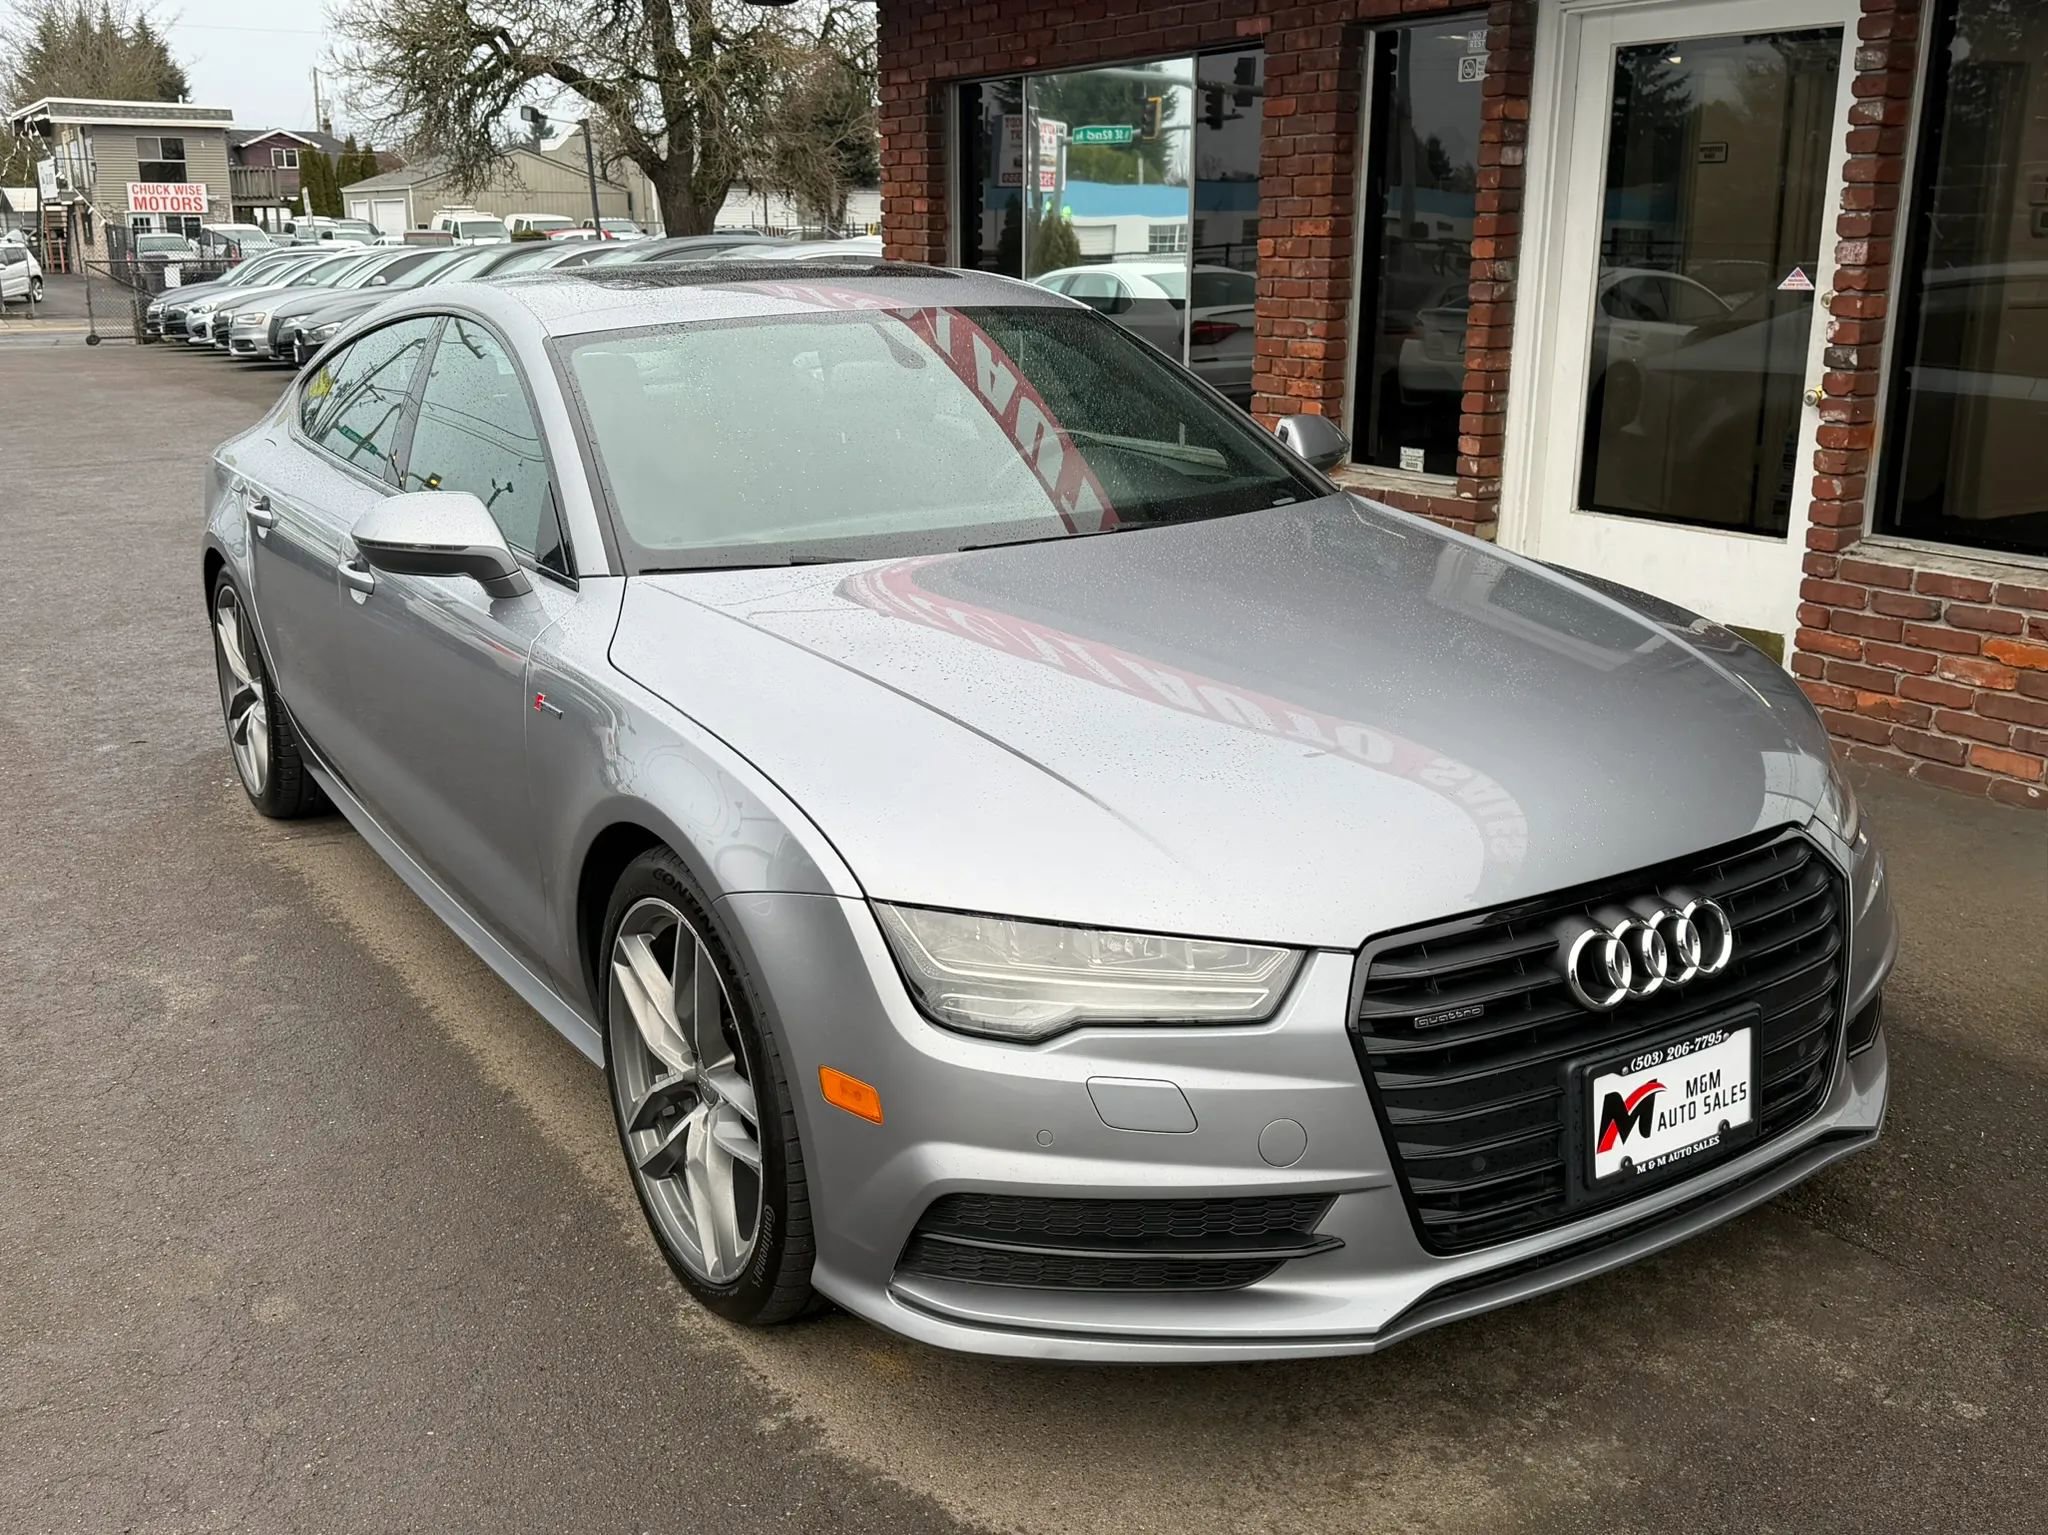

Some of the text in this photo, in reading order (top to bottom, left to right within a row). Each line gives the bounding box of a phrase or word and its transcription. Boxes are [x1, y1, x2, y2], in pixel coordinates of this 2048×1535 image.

[131, 184, 203, 196] CHUCK WISE
[133, 196, 204, 212] MOTORS
[1418, 1007, 1482, 1027] quattro
[1630, 1029, 1723, 1072] (503) 206-7795
[1686, 1069, 1721, 1099] M&M
[1657, 1081, 1747, 1132] AUTO SALES
[1636, 1135, 1721, 1175] M & M AUTO SALES
